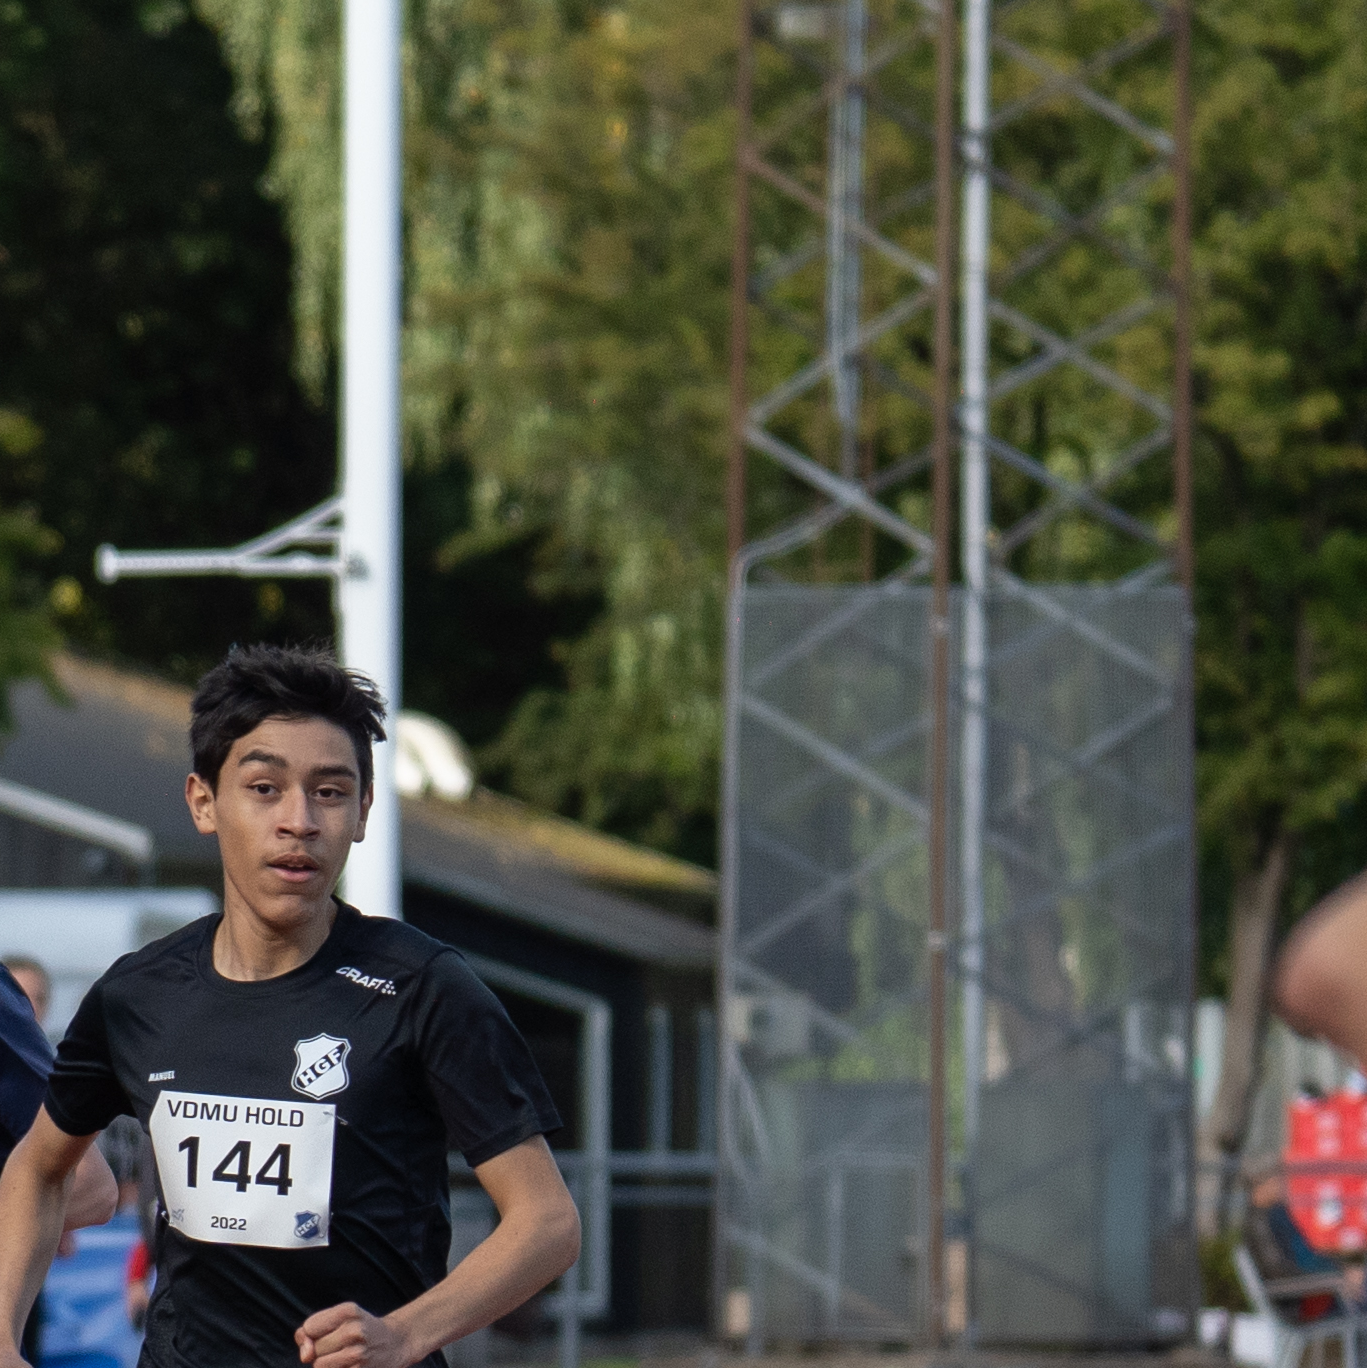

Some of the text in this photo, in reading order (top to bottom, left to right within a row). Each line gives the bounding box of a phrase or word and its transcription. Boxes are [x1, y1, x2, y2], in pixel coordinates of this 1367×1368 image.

[336, 966, 386, 990] CRAFT
[298, 1048, 341, 1087] HGF
[167, 1099, 304, 1127] VDMU HOLD
[178, 1135, 293, 1196] 144
[210, 1216, 247, 1231] 2022
